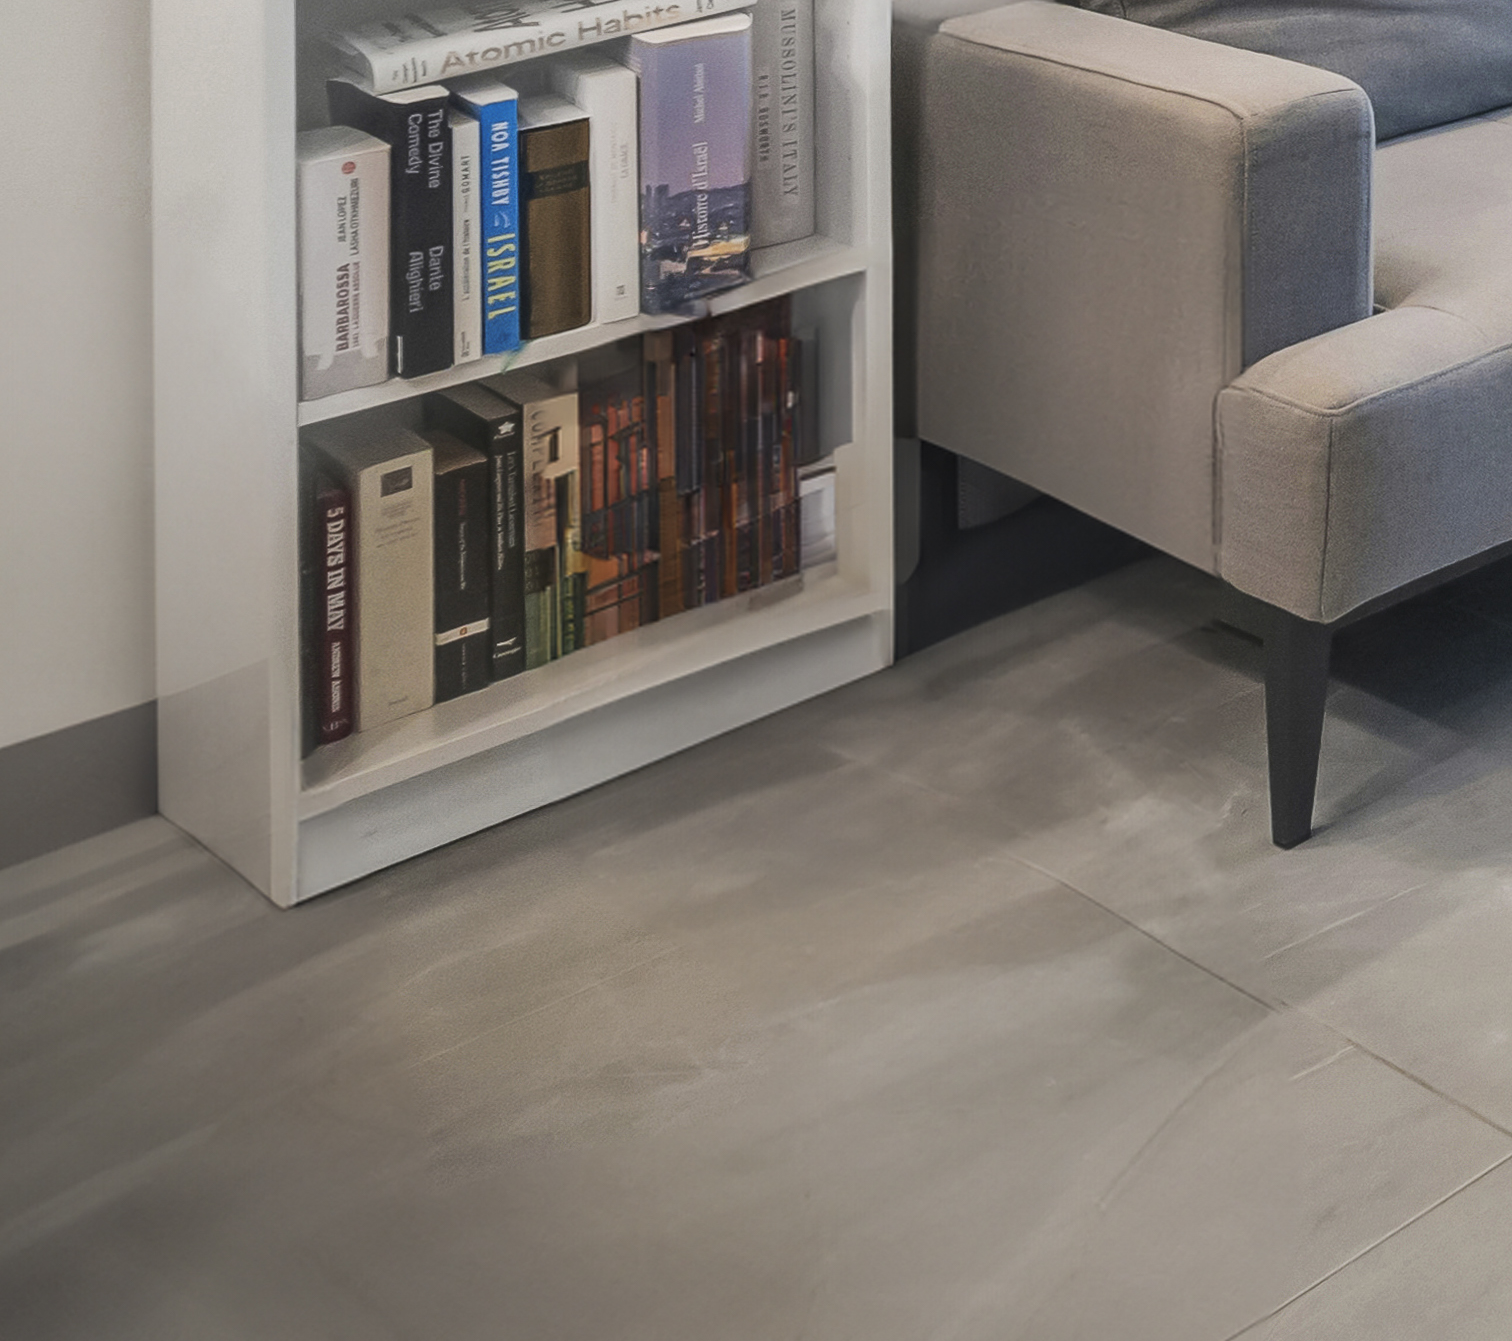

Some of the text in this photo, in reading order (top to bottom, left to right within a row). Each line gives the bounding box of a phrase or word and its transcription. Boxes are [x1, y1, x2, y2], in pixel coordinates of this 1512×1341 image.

[440, 0, 681, 75] Atomic Habits
[405, 113, 423, 174] Comedy
[781, 9, 798, 197] MUSSOLINI'S ITALY
[428, 109, 444, 188] The Divine
[492, 121, 509, 205] NOA TISHBY
[337, 196, 347, 242] JEAN LOPEZ
[692, 141, 709, 246] Histoire d'Israël
[335, 263, 350, 352] BARBAROSSA
[406, 251, 423, 313] Alighieri
[428, 246, 444, 291] Dante
[487, 233, 516, 320] ISRAEL
[326, 506, 345, 632] 5 DAYS IN MAY
